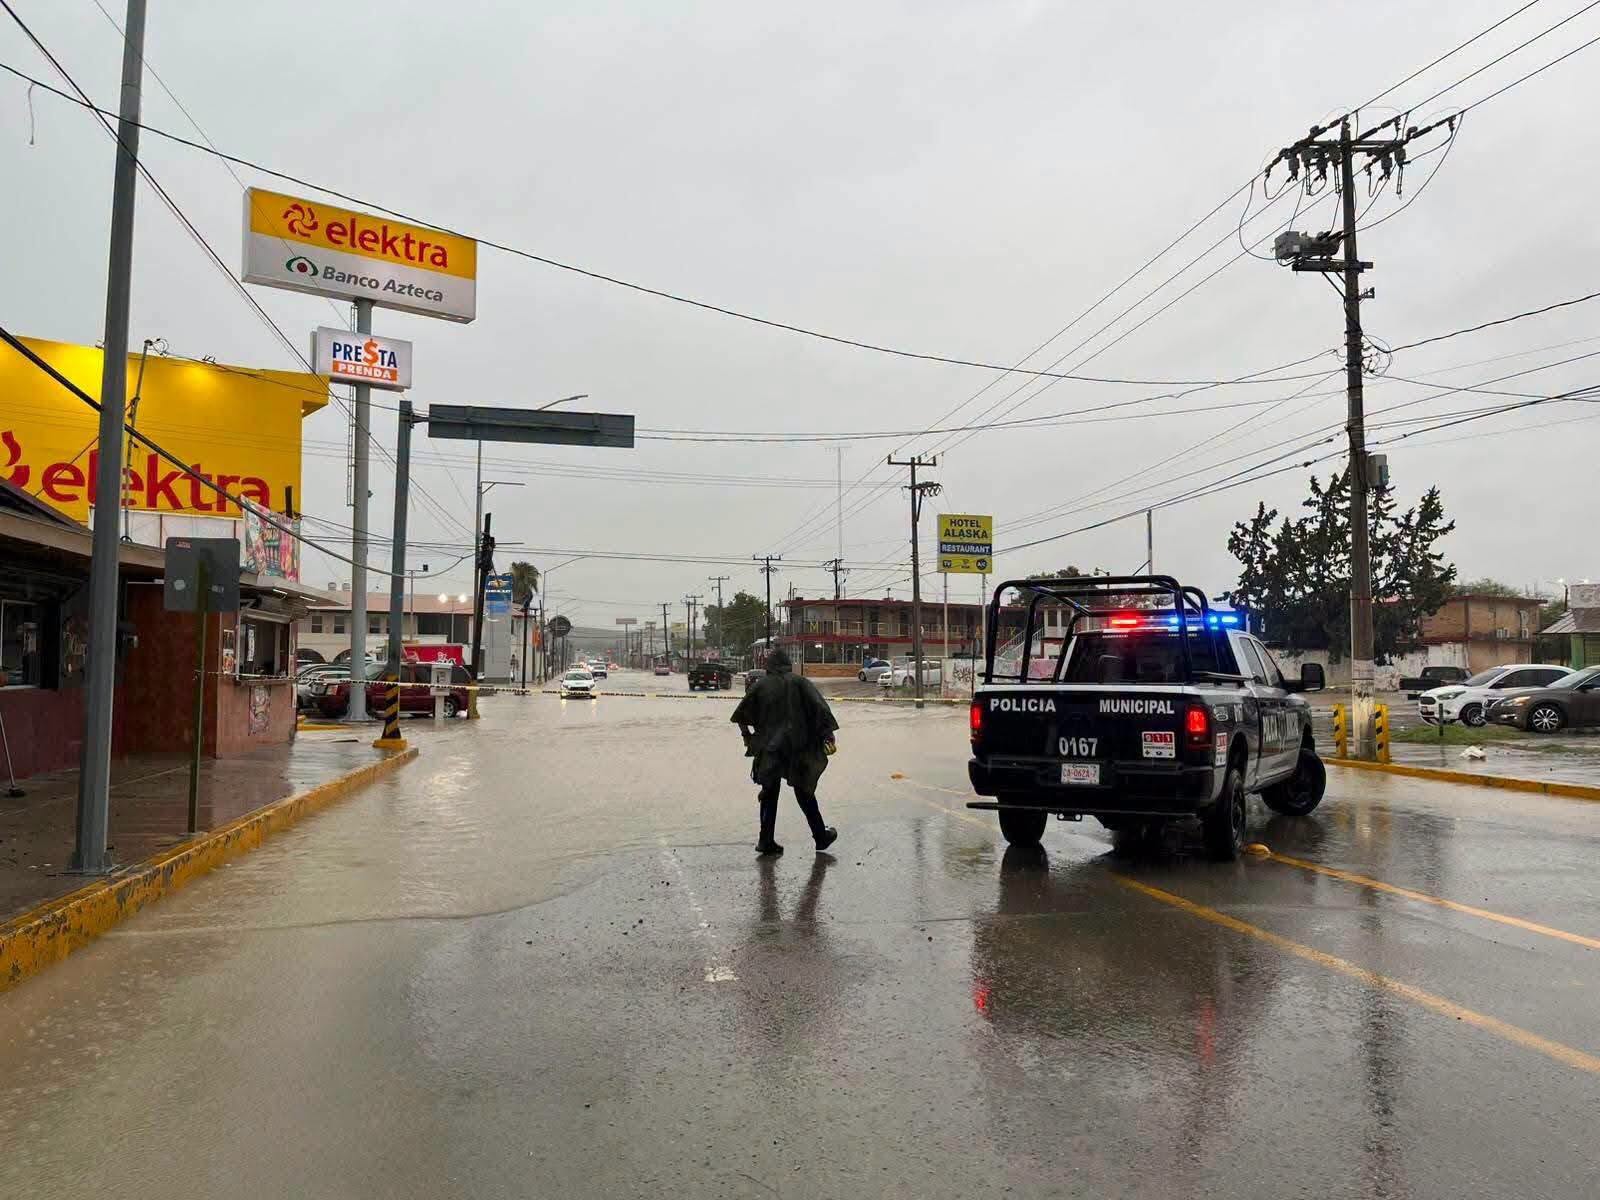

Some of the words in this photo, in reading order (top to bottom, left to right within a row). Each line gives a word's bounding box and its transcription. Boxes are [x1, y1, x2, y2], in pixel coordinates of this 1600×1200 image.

[326, 218, 448, 268] elektra
[322, 266, 380, 289] Banco
[383, 279, 443, 302] Azteca
[337, 362, 392, 380] PRENDA
[950, 519, 981, 528] HOTEL
[944, 528, 988, 538] ALASKA
[942, 544, 989, 552] RESTAURANT
[989, 698, 1057, 713] POLICIA
[1099, 699, 1175, 715] MUNICIPAL
[1058, 736, 1099, 757] 0167
[1144, 733, 1171, 743] 911
